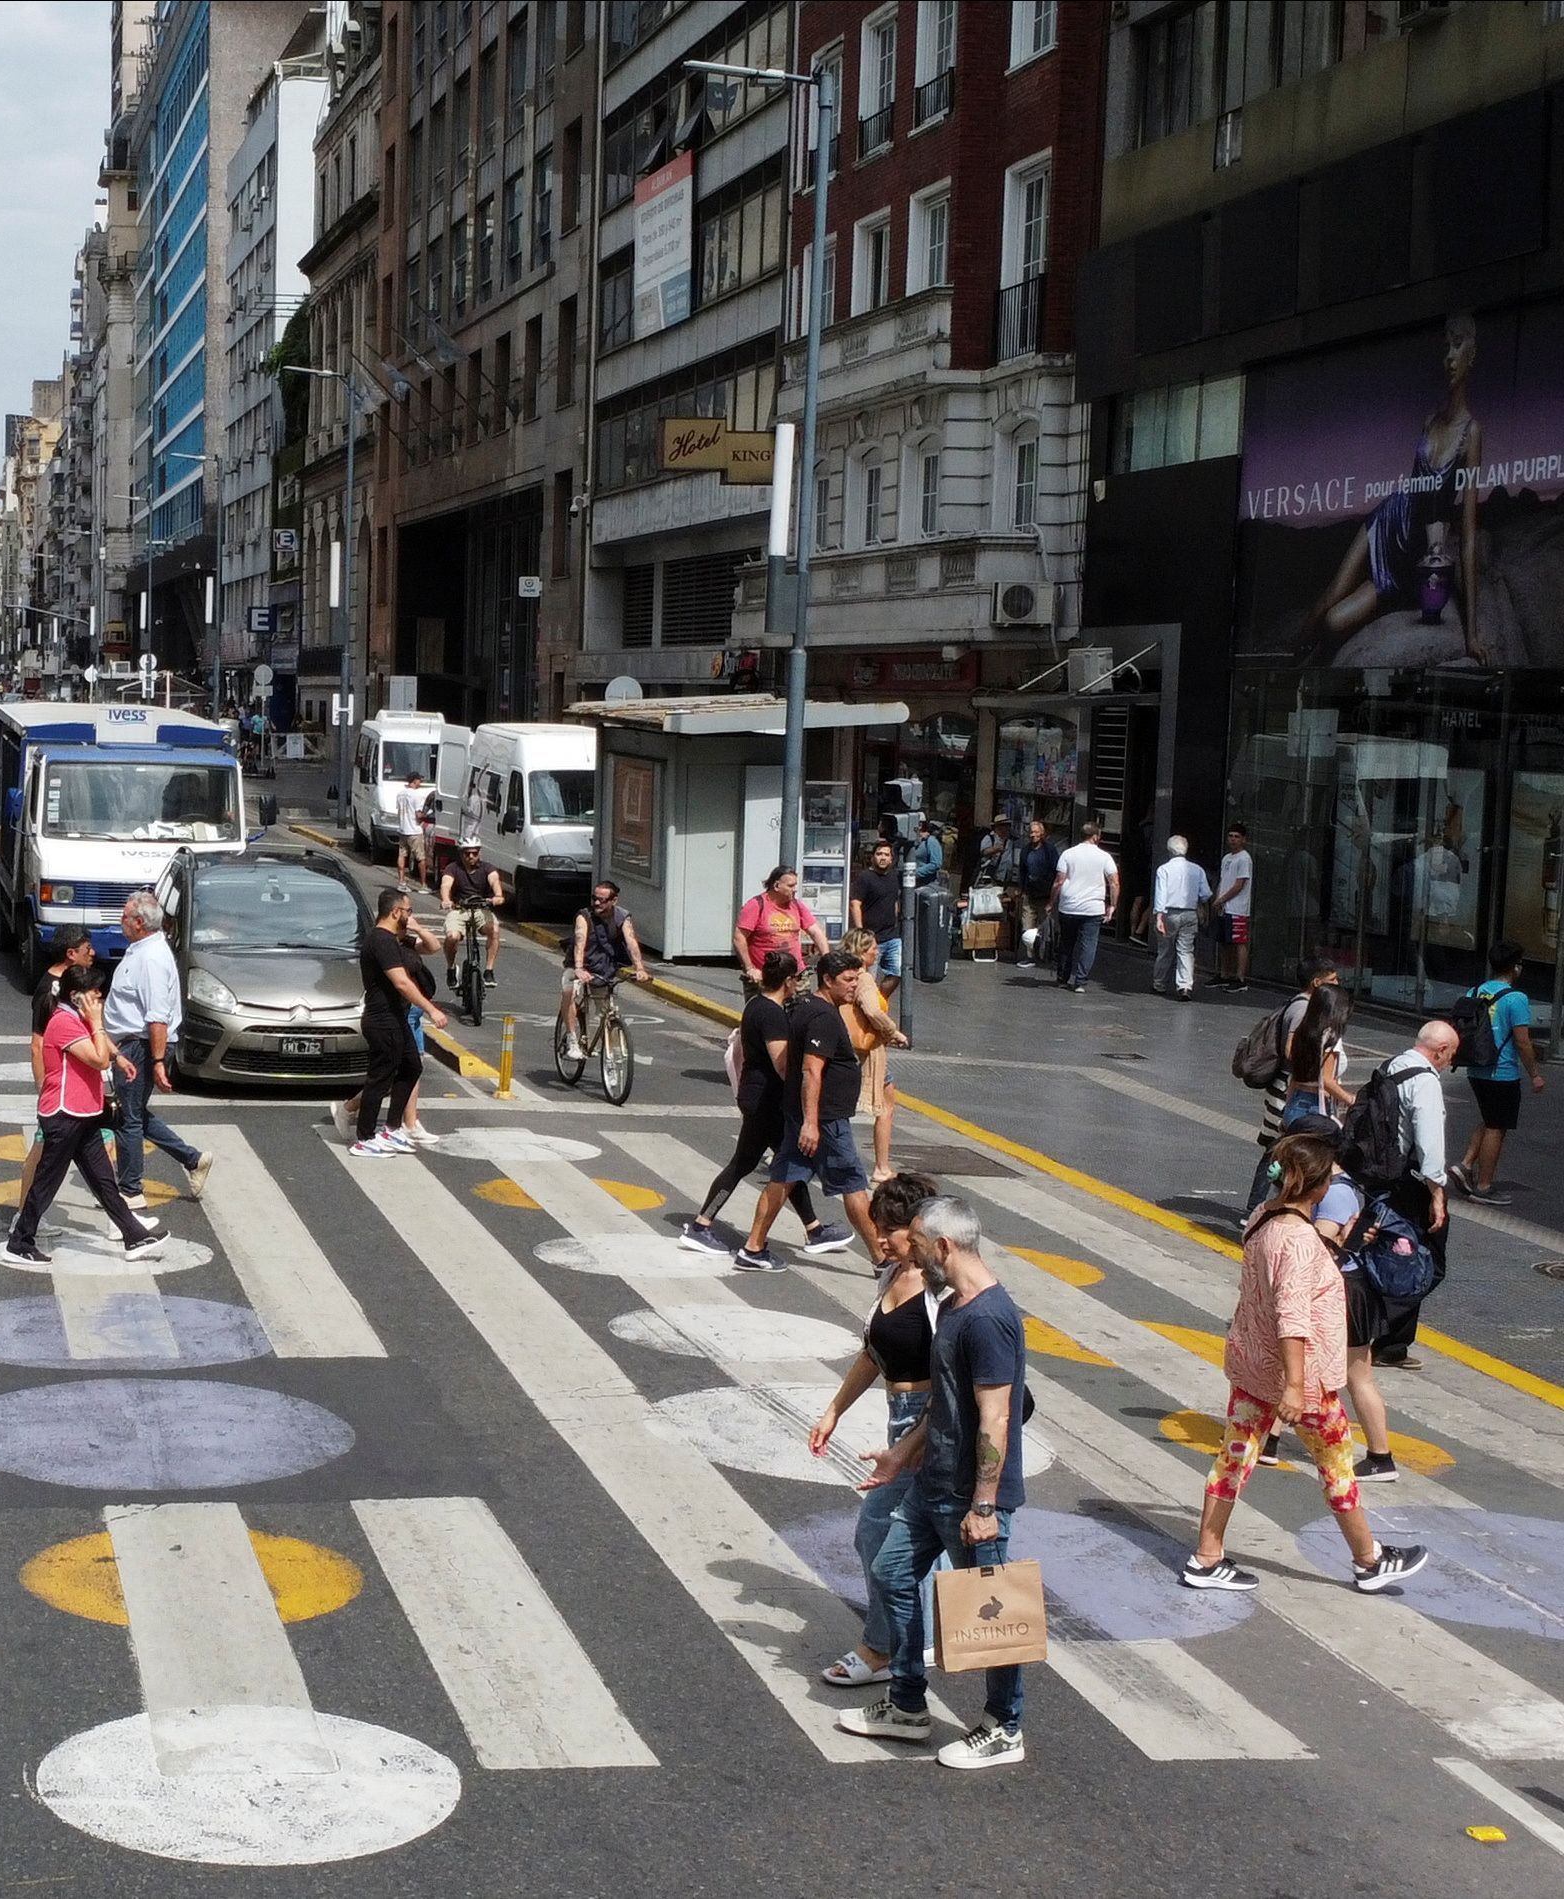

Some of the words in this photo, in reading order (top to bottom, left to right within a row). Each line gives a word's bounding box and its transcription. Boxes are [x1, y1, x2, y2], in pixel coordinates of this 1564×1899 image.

[668, 423, 721, 462] Hotel
[1247, 476, 1356, 520] VERSACE
[1364, 478, 1397, 504] pour
[1397, 472, 1443, 496] femme
[1454, 462, 1509, 492] DYLAN
[251, 608, 270, 631] E
[955, 1622, 1029, 1643] INSTINTO
